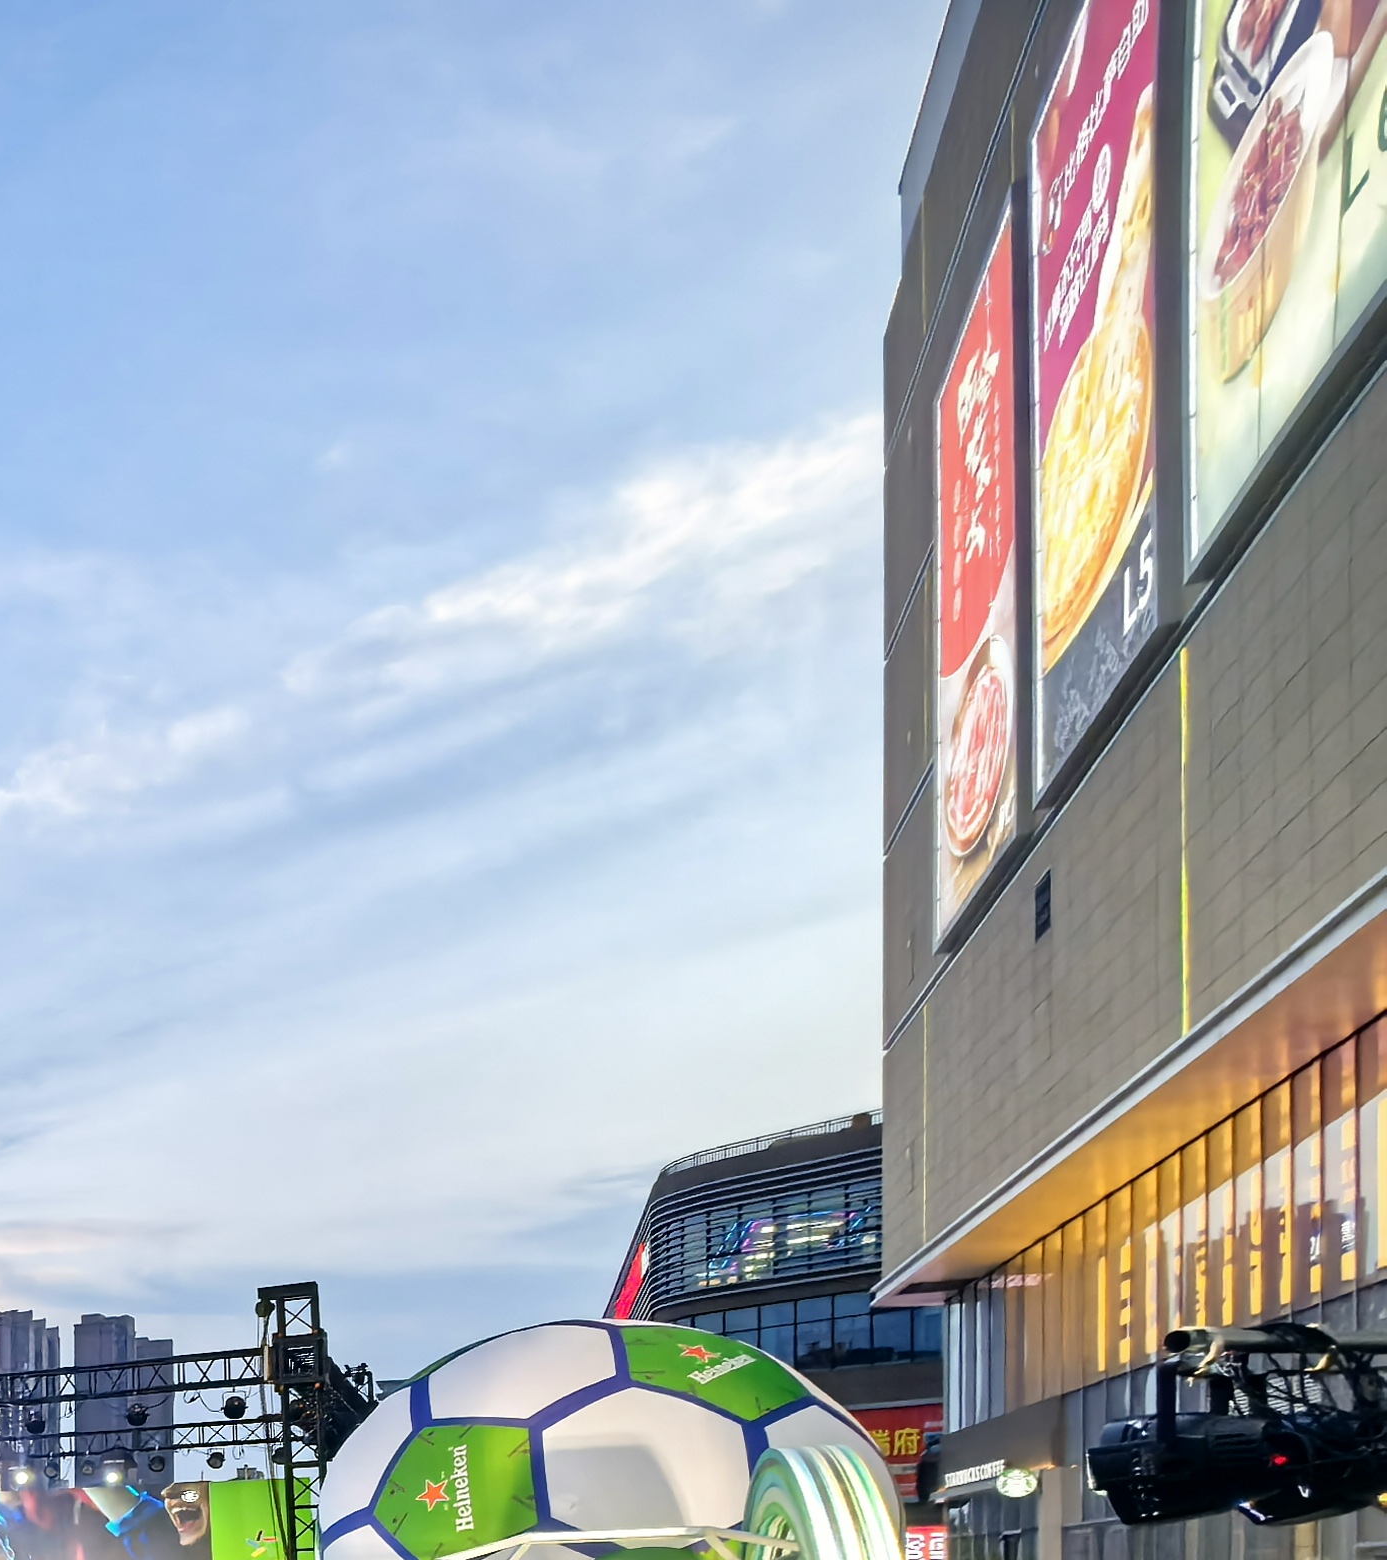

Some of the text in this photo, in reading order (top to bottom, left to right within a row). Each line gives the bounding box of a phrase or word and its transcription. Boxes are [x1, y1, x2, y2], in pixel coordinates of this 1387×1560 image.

[1123, 529, 1153, 637] L5
[687, 1353, 756, 1385] Heineken
[454, 1444, 474, 1533] Heineken
